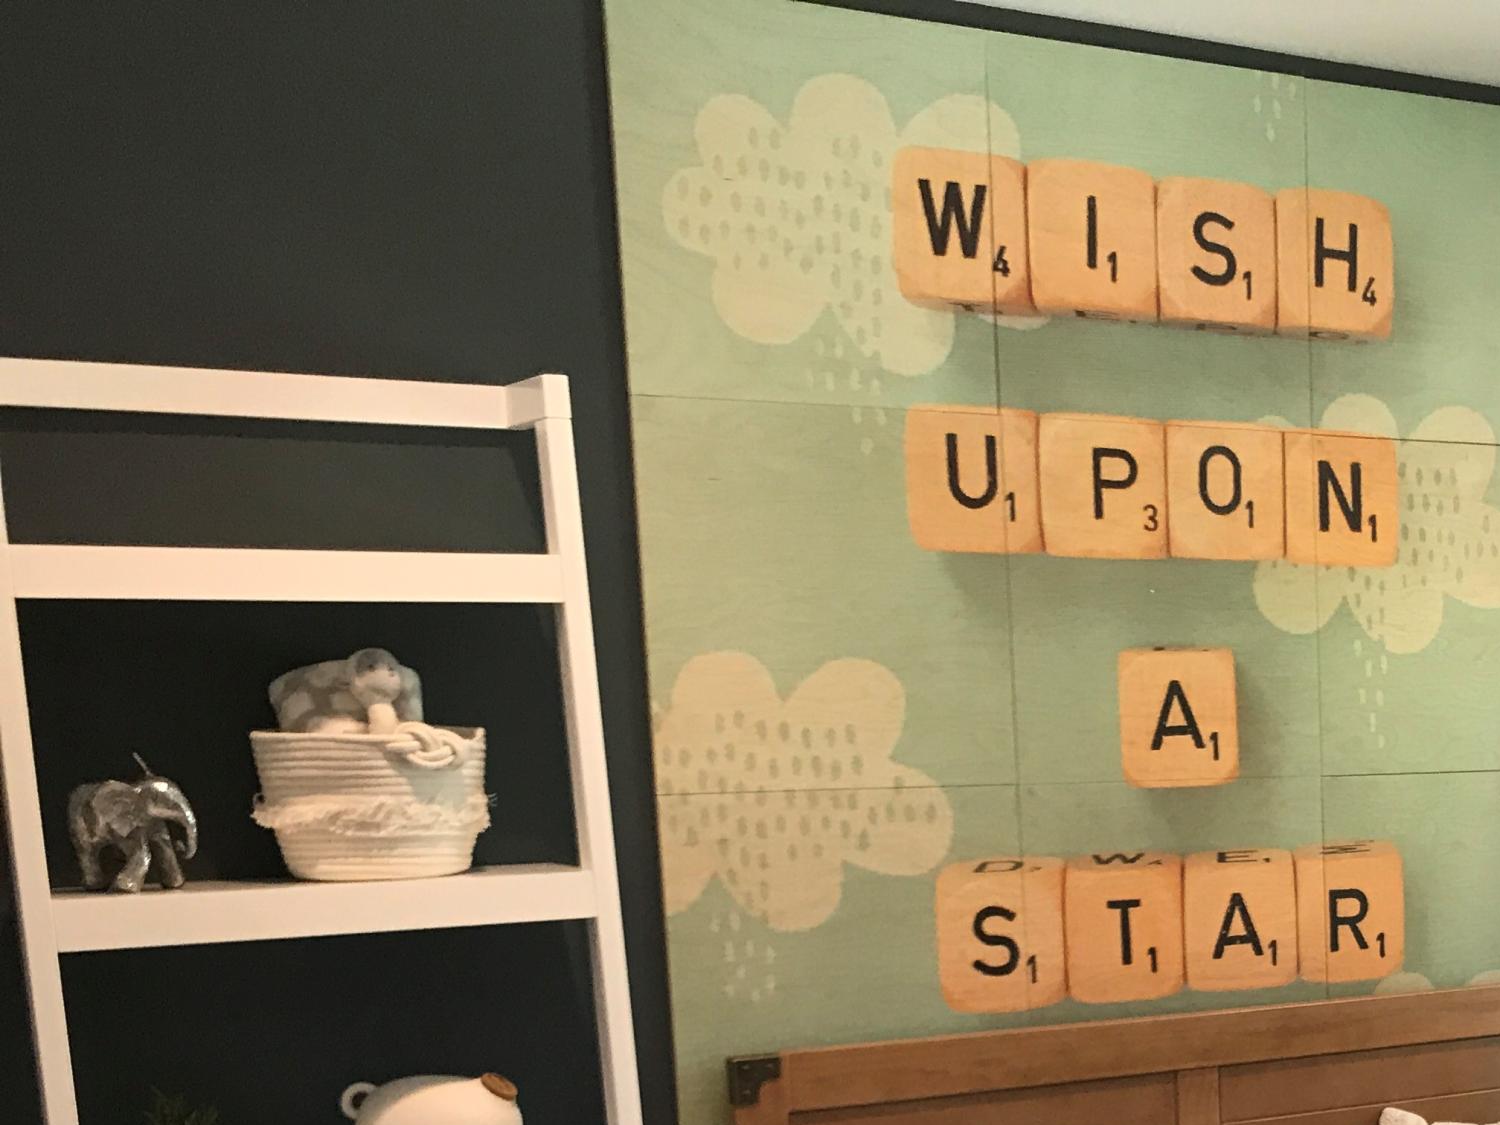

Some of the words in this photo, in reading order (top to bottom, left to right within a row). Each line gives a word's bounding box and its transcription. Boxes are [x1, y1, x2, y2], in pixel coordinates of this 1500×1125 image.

[917, 178, 1358, 293] WISH
[992, 245, 1011, 277] 4
[1106, 251, 1118, 283] 1
[1241, 270, 1253, 300] 1
[1362, 277, 1378, 306] 4
[945, 432, 1362, 533] UPON
[1004, 491, 1017, 522] 1
[1143, 504, 1159, 532] 3
[1245, 500, 1255, 529] 1
[1367, 514, 1378, 542] 1
[1150, 679, 1206, 751] A
[1208, 731, 1221, 761] 1
[972, 888, 1369, 977] STAR
[1025, 954, 1038, 984] 1
[1147, 946, 1159, 974] 1
[1267, 939, 1278, 967] 1
[1375, 932, 1387, 959] 1
